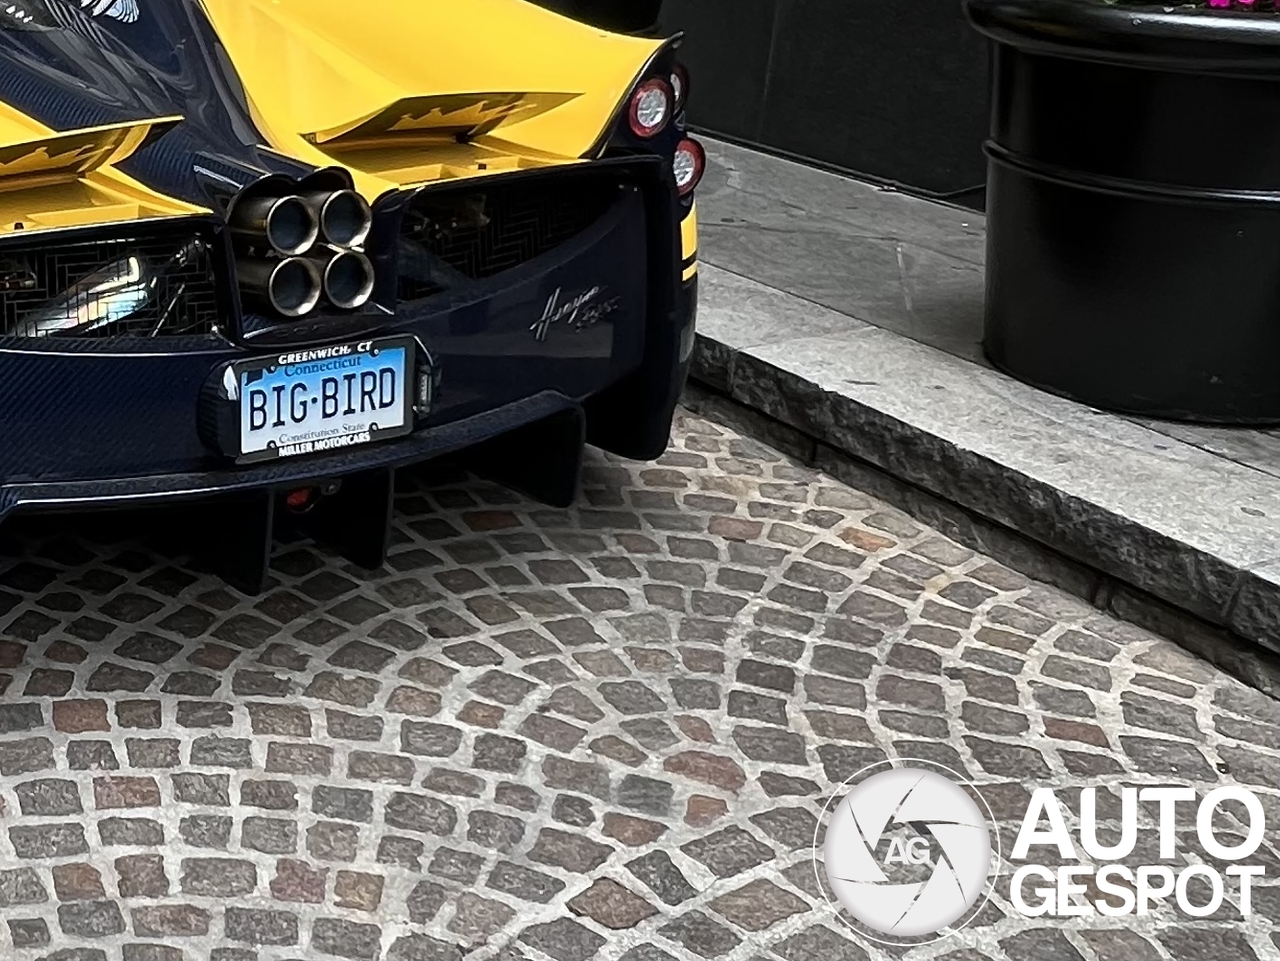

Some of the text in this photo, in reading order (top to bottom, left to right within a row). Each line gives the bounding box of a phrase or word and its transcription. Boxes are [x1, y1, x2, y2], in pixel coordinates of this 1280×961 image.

[357, 341, 373, 352] CT
[284, 356, 362, 377] Connecticut
[279, 422, 365, 444] Constitution State
[278, 431, 371, 457] MILLER MOTORCARS
